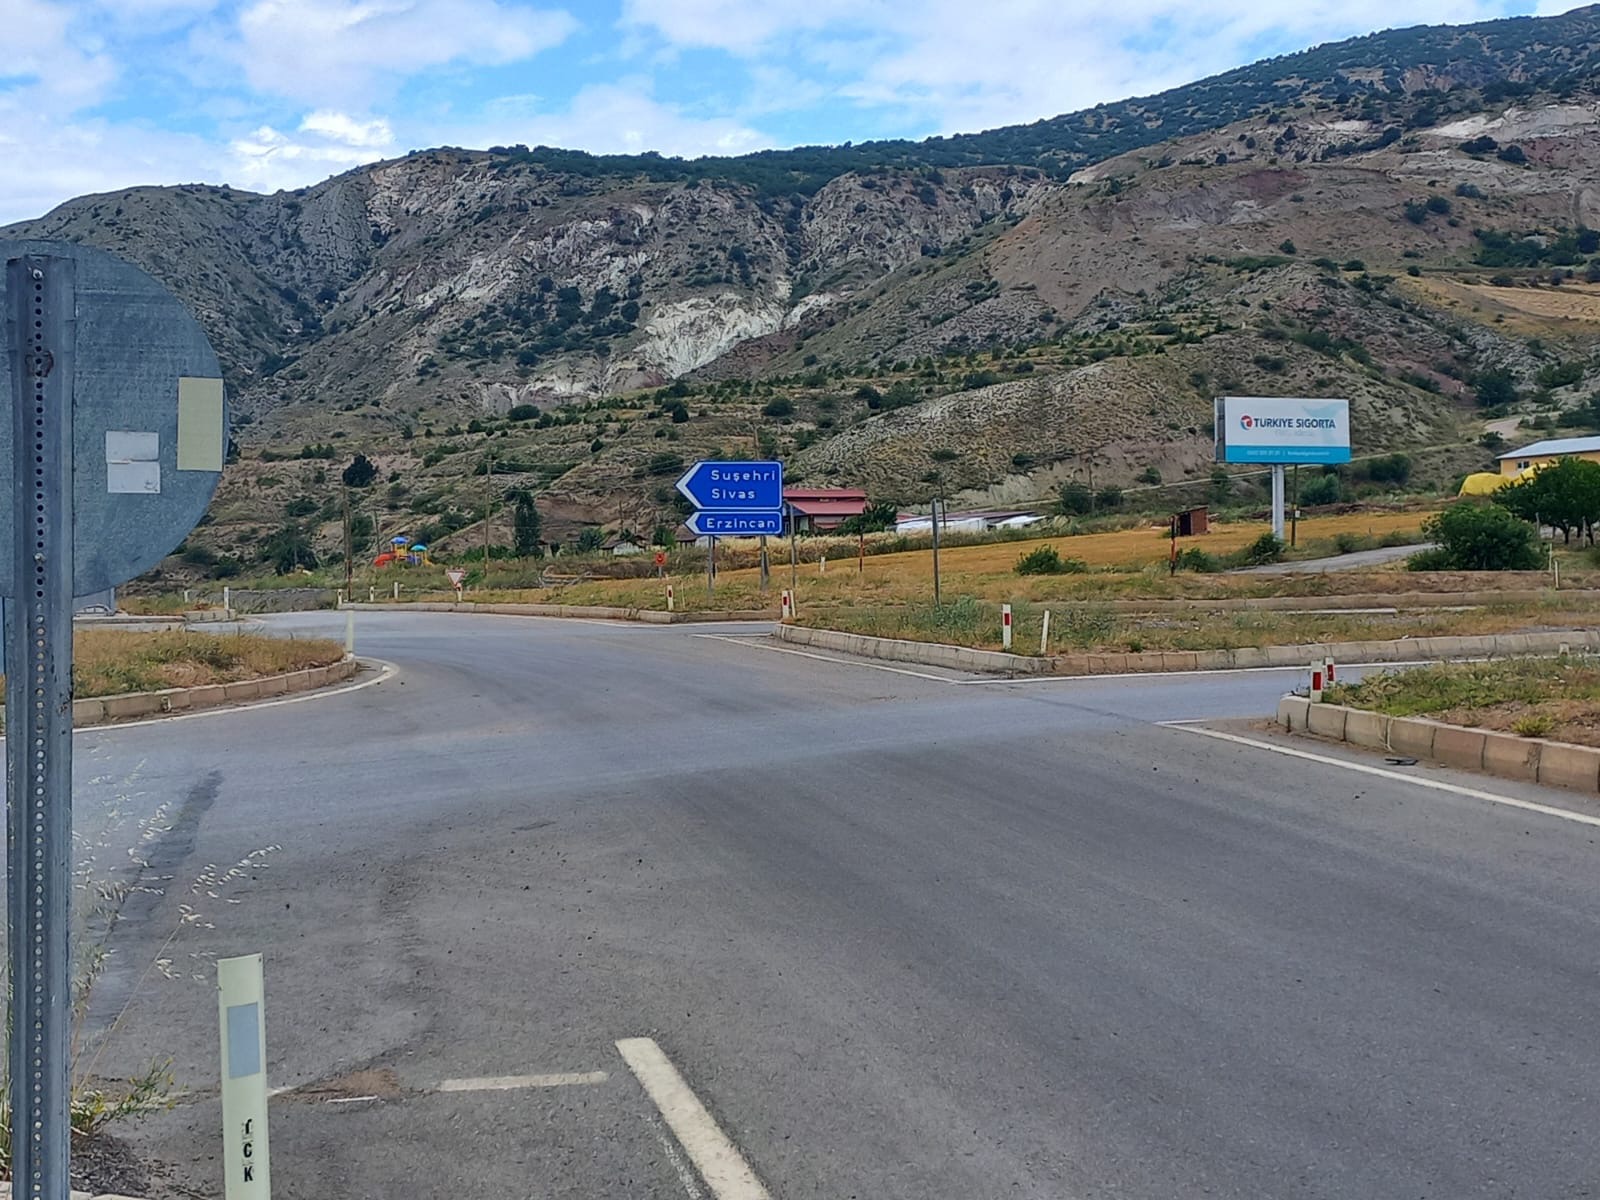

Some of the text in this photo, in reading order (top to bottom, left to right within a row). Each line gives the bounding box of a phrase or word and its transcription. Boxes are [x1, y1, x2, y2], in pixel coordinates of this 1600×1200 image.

[711, 469, 775, 482] Suşehri
[711, 488, 755, 499] Sivas
[706, 518, 775, 528] Erzincan
